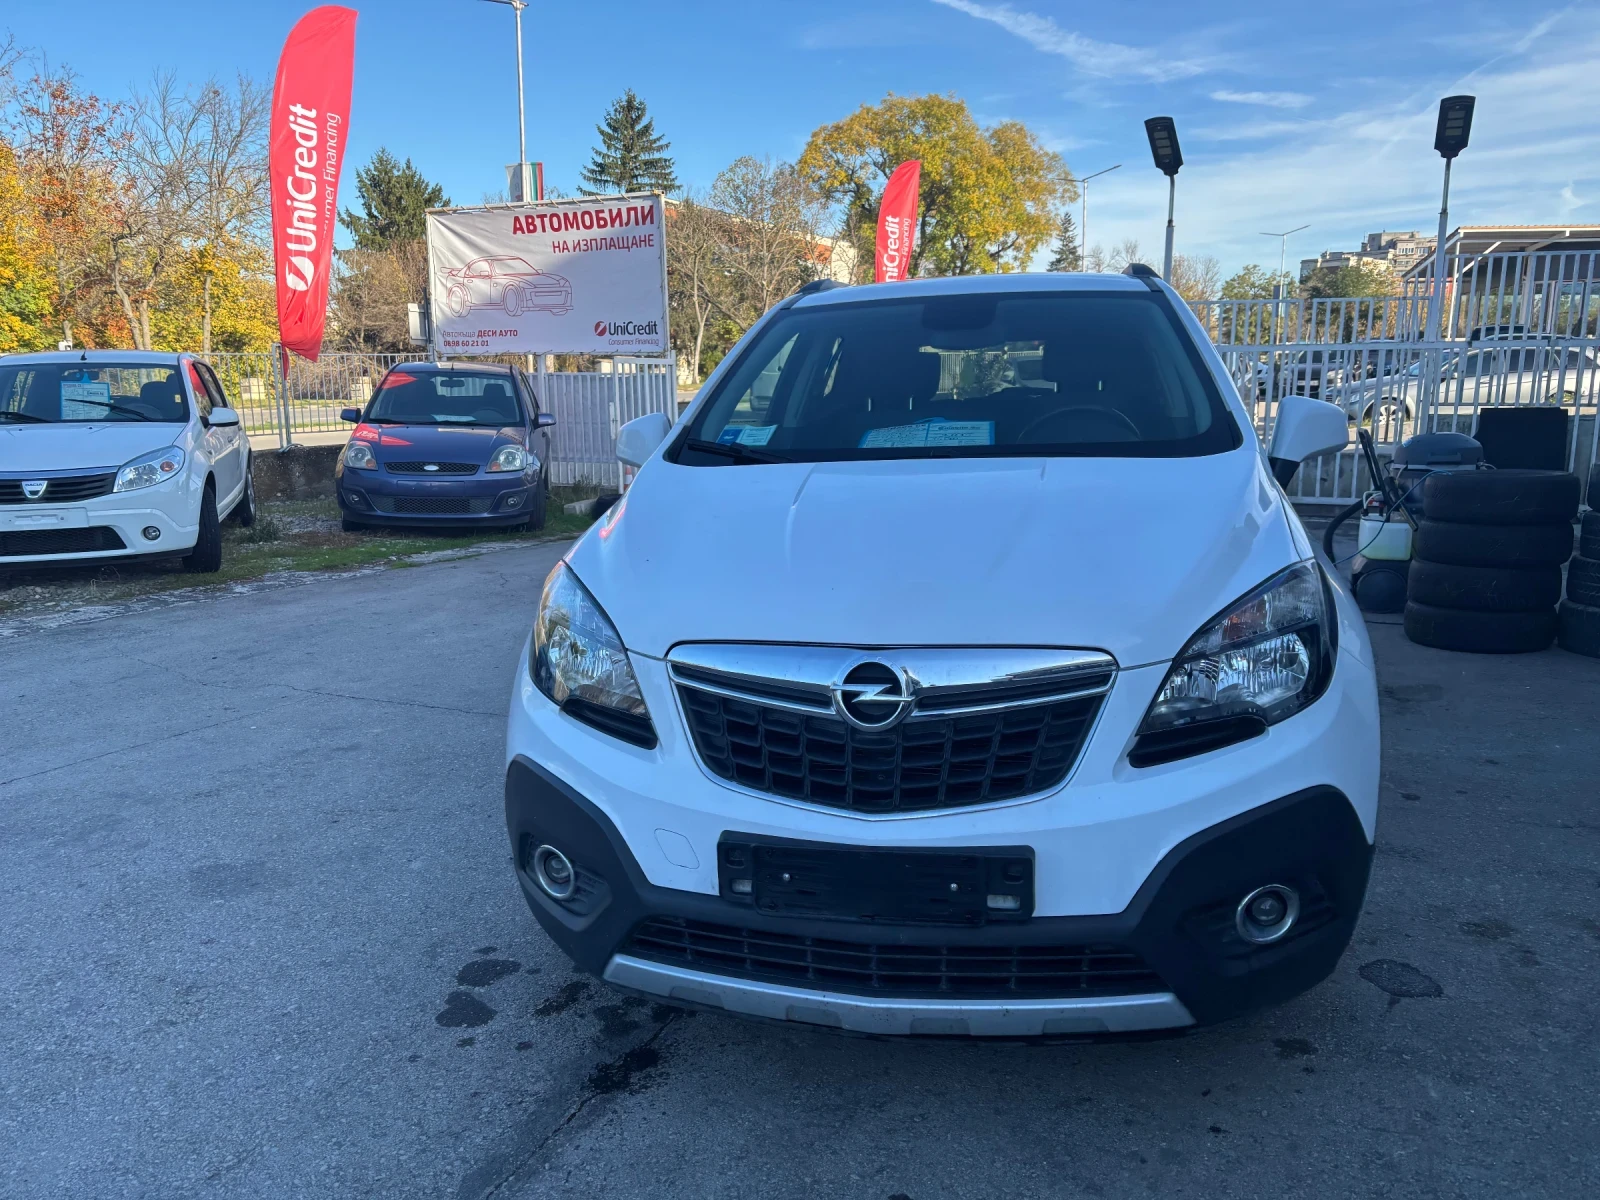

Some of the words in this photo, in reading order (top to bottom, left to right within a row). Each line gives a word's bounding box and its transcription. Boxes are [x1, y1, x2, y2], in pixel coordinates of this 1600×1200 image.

[324, 112, 342, 182] Financing
[287, 103, 317, 252] UniCredit
[512, 204, 655, 235] АВТОМОБИЛИ
[552, 240, 570, 253] НА
[573, 234, 655, 253] ИЗПЛАЩАНЕ
[477, 330, 497, 339] ДЕСИ
[498, 329, 518, 337] АУТО
[608, 321, 659, 336] UniCredit
